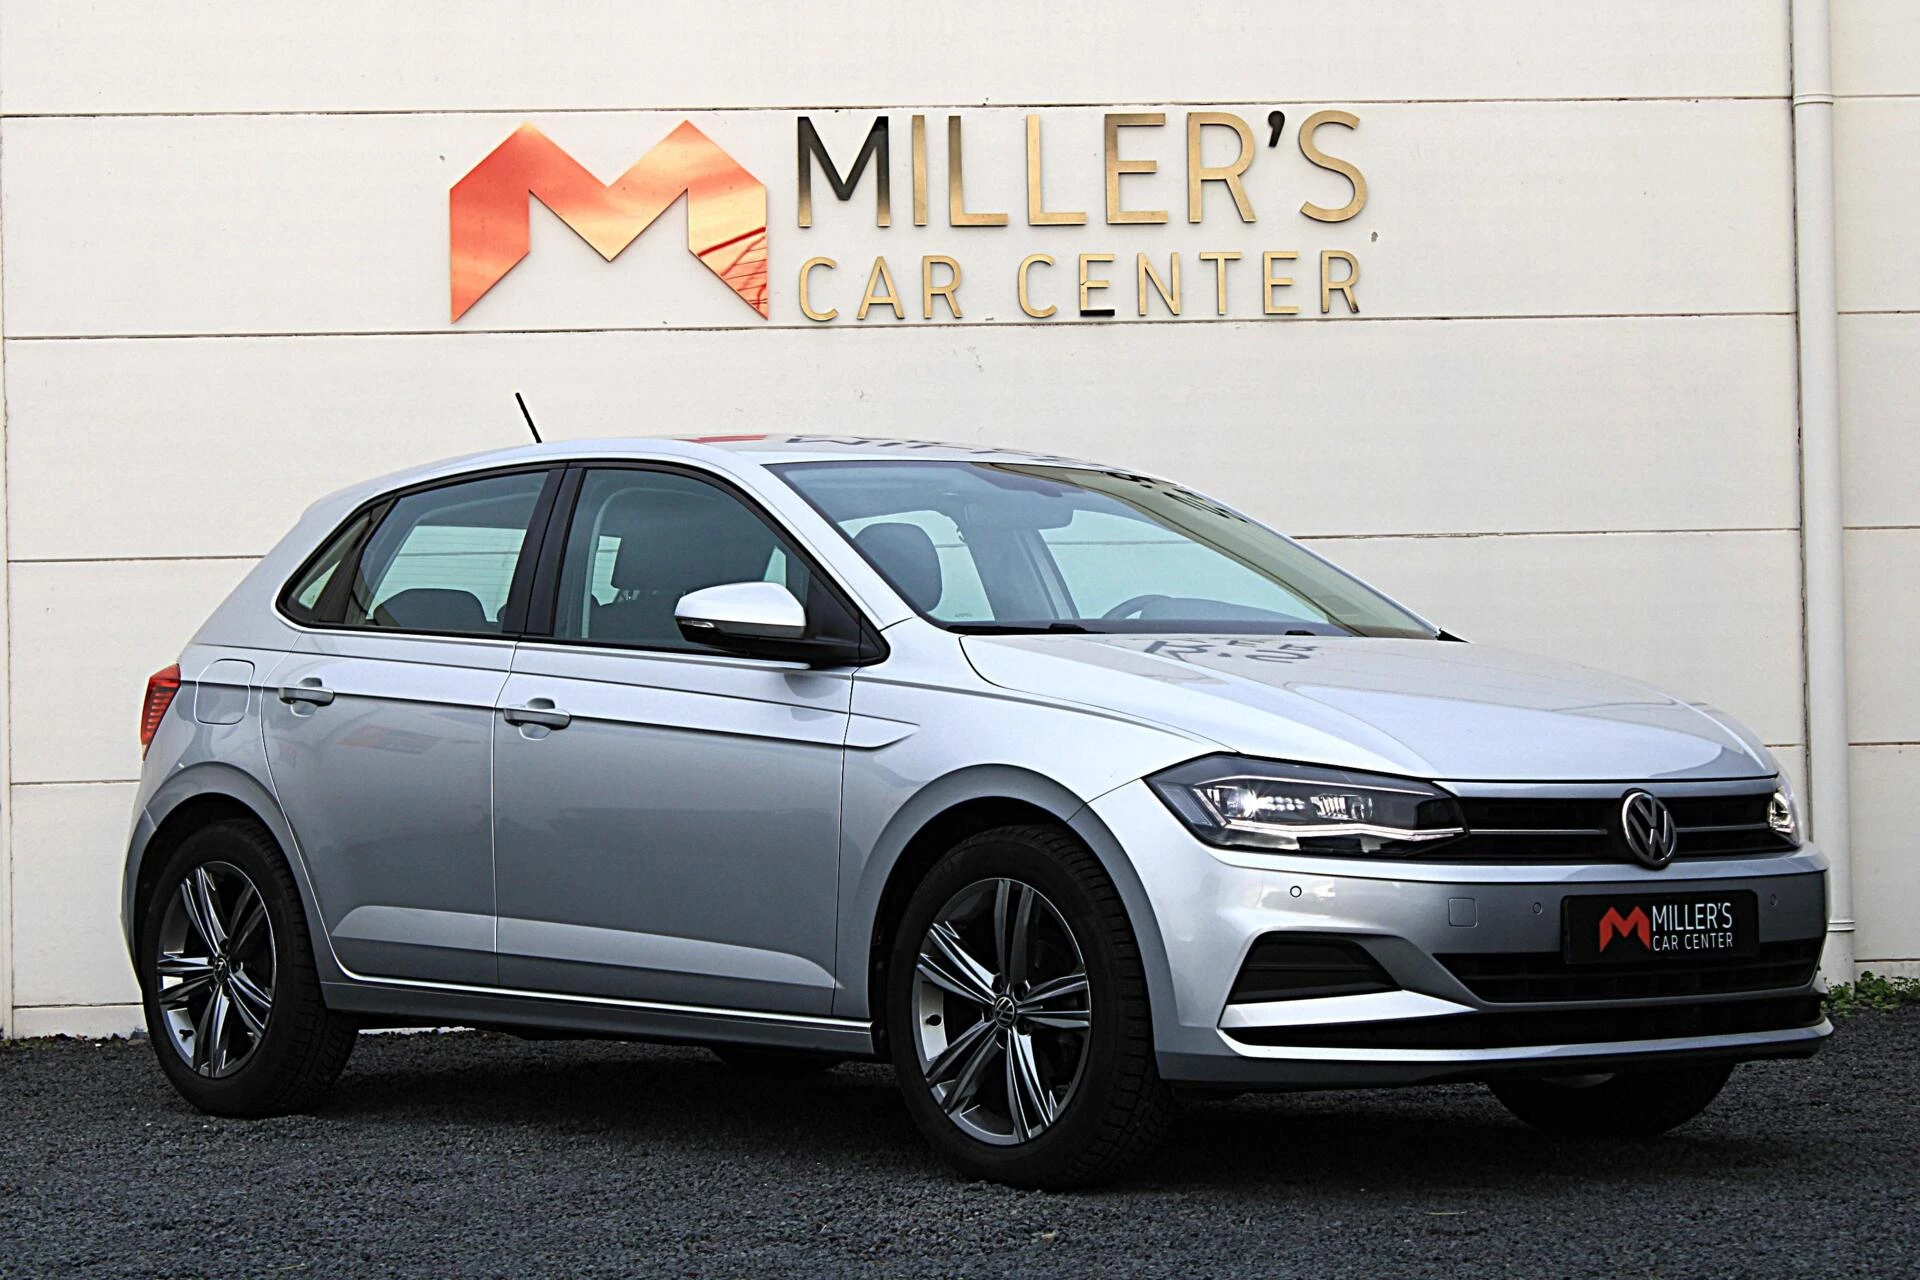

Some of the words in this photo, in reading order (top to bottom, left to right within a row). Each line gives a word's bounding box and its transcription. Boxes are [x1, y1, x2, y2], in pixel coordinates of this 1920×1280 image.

[797, 110, 1368, 229] MILLER'S
[799, 256, 963, 322] CAR
[1017, 250, 1360, 319] CENTER
[1652, 902, 1733, 932] MILLER'S
[1652, 935, 1679, 951] CAR
[1684, 932, 1733, 949] CENTER
